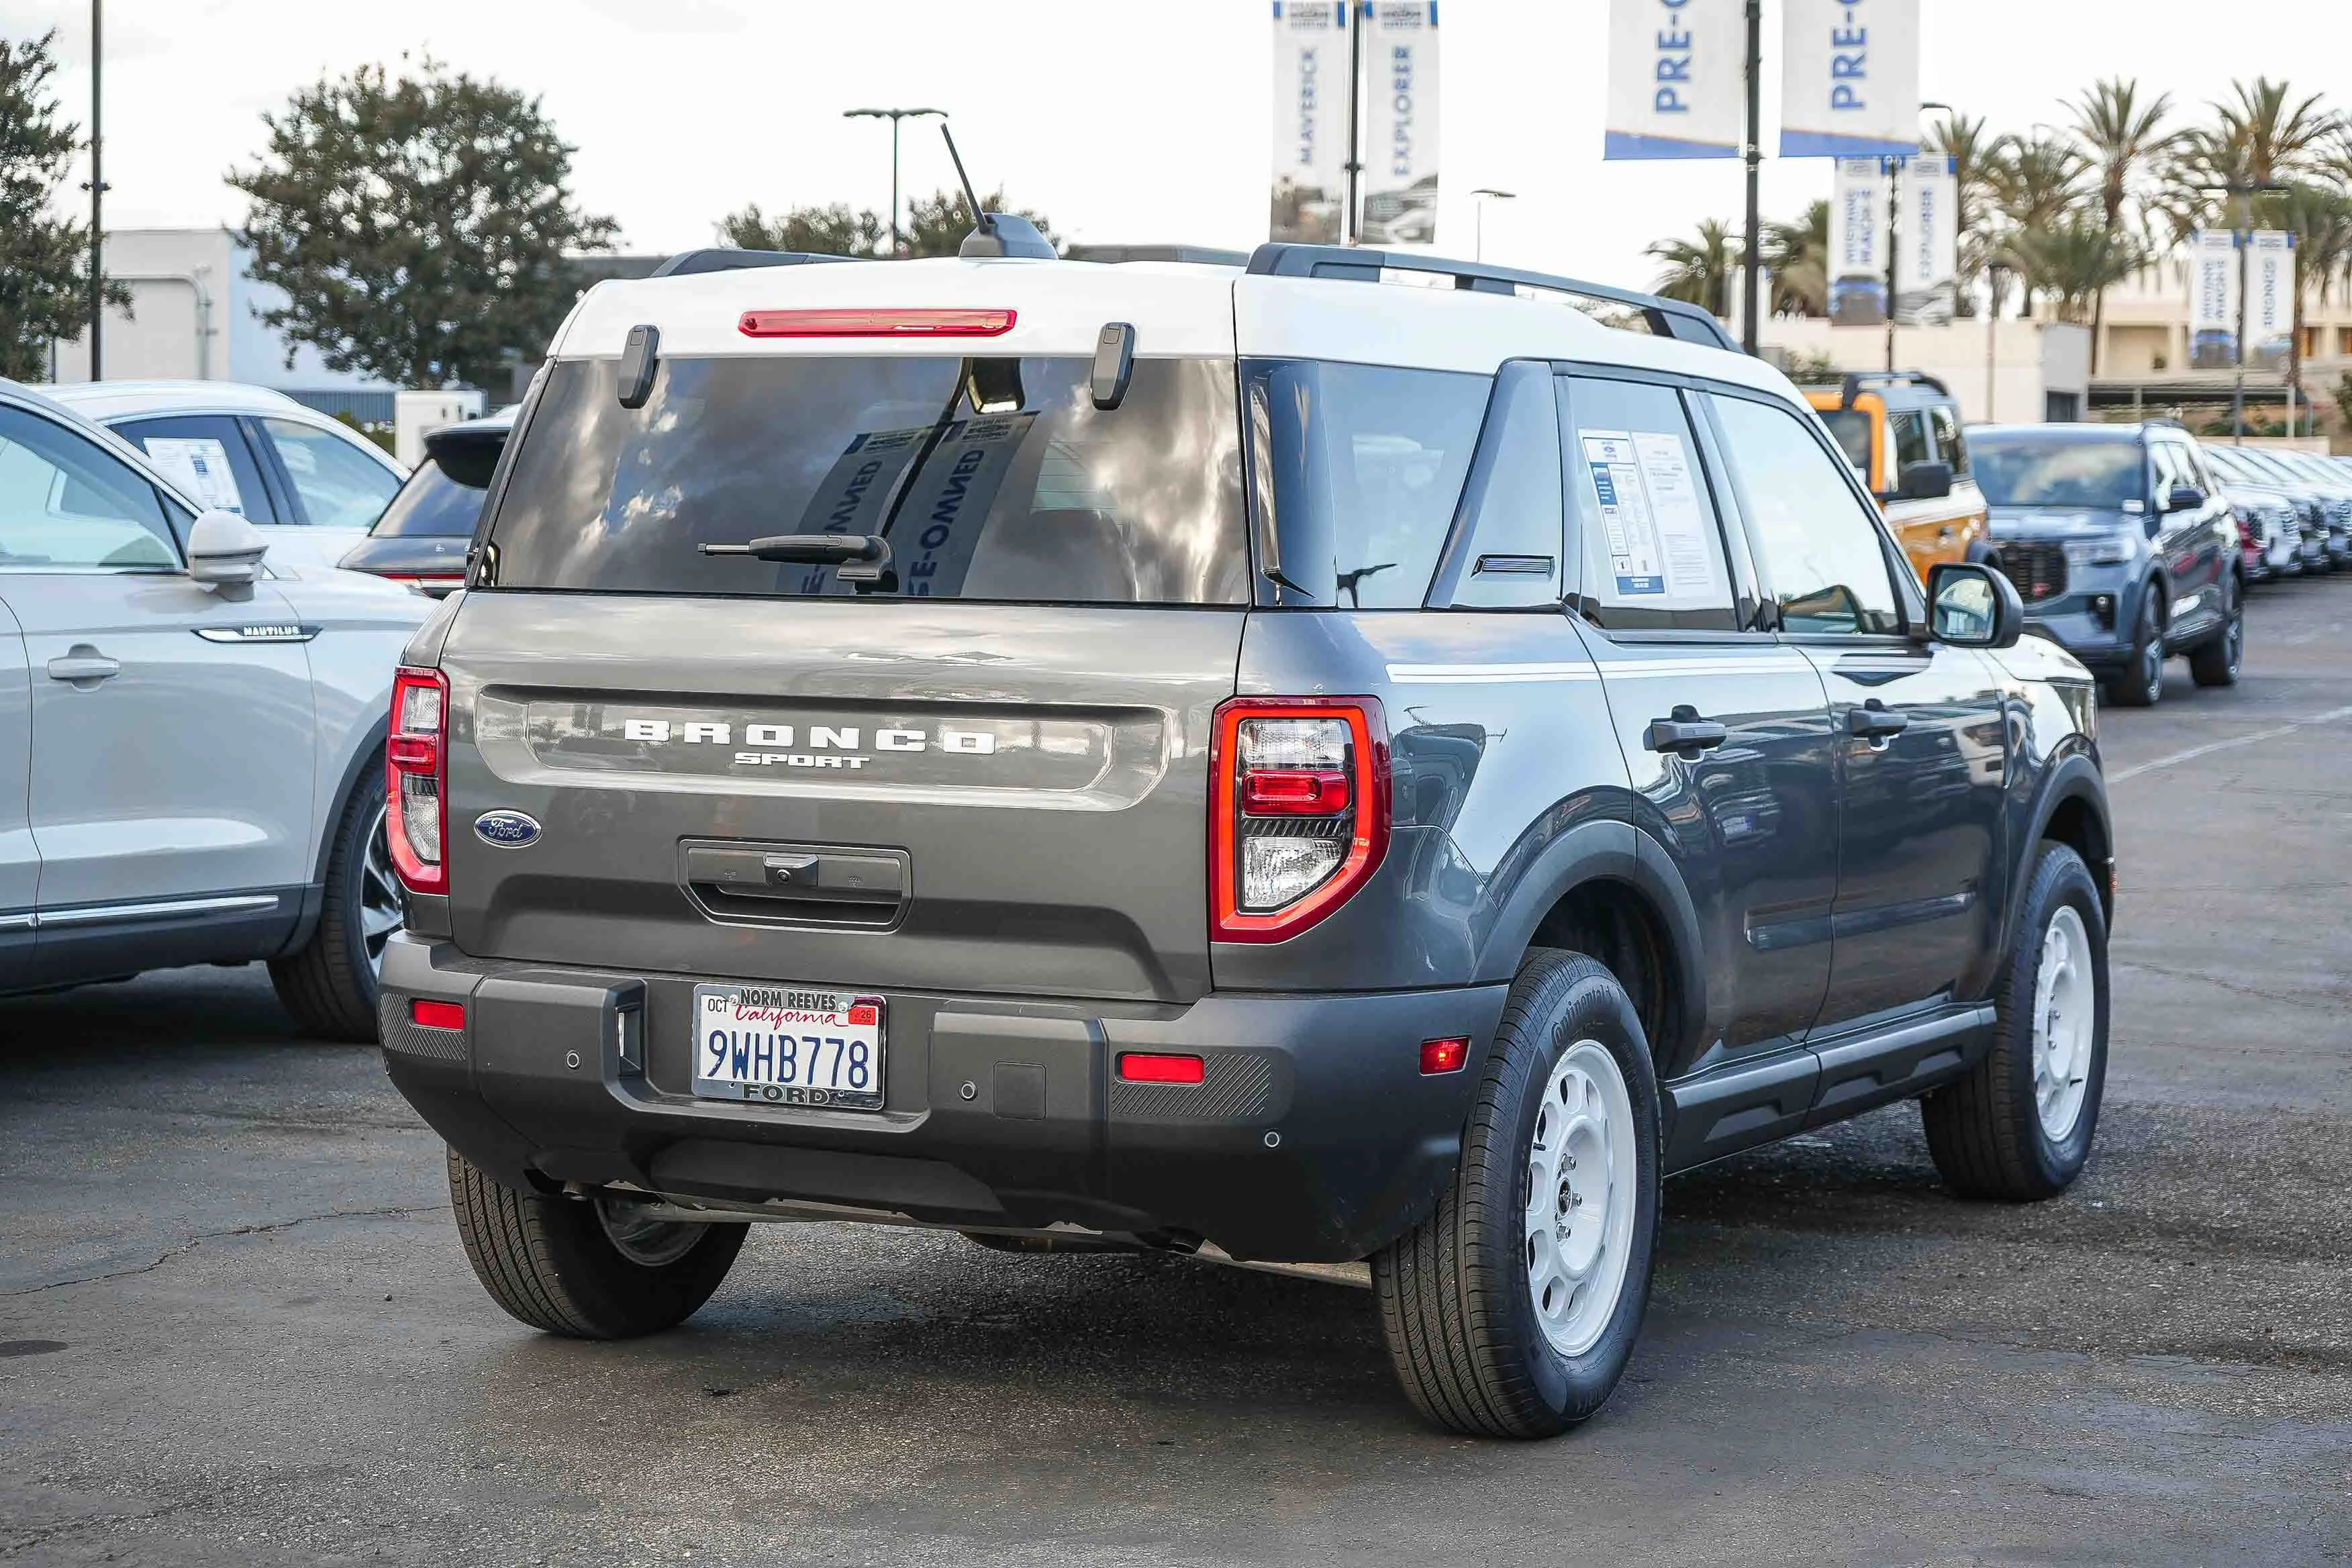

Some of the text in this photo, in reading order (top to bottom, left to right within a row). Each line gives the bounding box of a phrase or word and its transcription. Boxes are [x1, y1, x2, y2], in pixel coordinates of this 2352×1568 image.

[1655, 0, 1691, 113] PRE-
[1832, 0, 1865, 109] PRE-
[1300, 48, 1318, 165] MAVERICK
[1393, 46, 1412, 176] EXPLORER
[243, 626, 299, 636] NAUTILUS
[624, 719, 995, 754] BRONCO
[734, 752, 870, 769] SPORT
[487, 817, 524, 838] Ford
[707, 998, 728, 1013] OCT
[740, 989, 836, 1011] NORM REEVES
[736, 1004, 848, 1030] California
[861, 1010, 871, 1018] 26
[707, 1030, 869, 1089] 9WHB778
[742, 1083, 830, 1105] FORD
